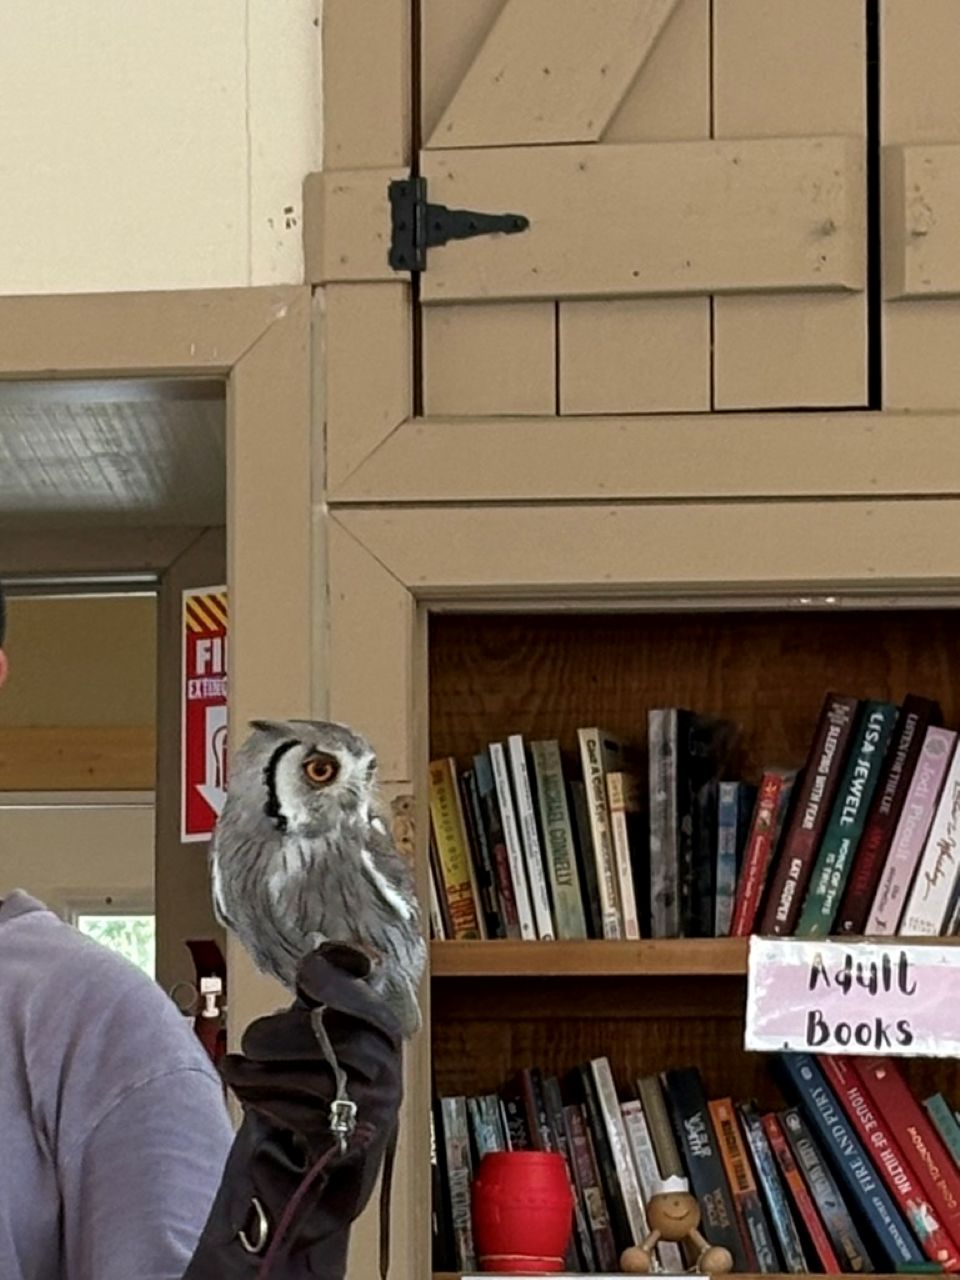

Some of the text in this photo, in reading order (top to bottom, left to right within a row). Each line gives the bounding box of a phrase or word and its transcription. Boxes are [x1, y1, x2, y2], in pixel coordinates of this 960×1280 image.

[196, 638, 227, 674] FI
[801, 724, 841, 830] SLEEPING WITH FEAR
[838, 710, 886, 829] LISA JEWELL
[542, 773, 573, 888] MICHAEL CONNELLY
[895, 761, 938, 862] Jodi Picoult
[774, 857, 803, 921] KAY HOOPER
[820, 838, 851, 916] NONE OF THIS
[808, 951, 917, 996] Adult
[807, 1009, 913, 1049] Books
[809, 1082, 840, 1127] FURY
[830, 1122, 858, 1159] AND
[845, 1085, 913, 1197] HOUSE OF HILTON
[849, 1155, 877, 1194] FIRE
